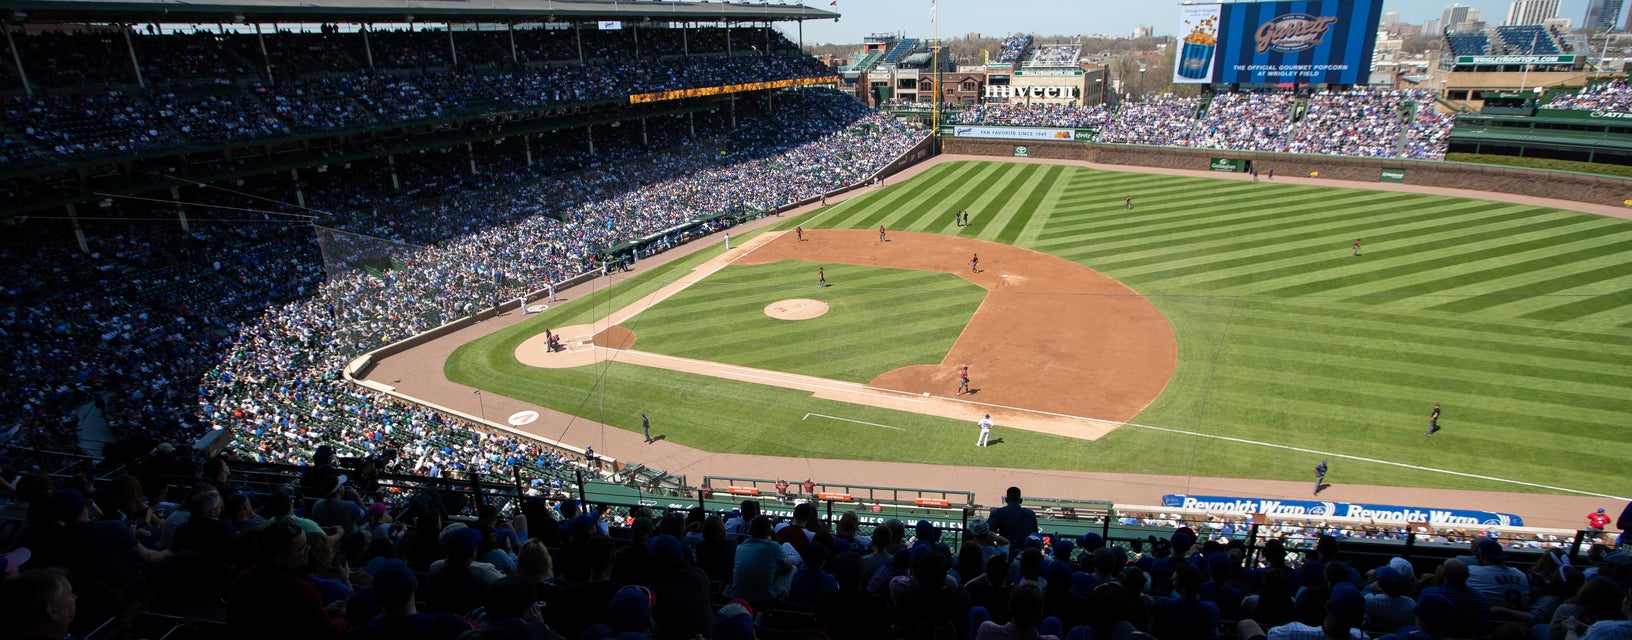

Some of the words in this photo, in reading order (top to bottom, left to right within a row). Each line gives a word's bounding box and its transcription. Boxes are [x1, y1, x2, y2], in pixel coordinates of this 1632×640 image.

[1255, 16, 1338, 54] Garrett
[1473, 56, 1559, 64] WRIGLEYROOFTOPS.COM
[983, 85, 1076, 99] nuveen
[1075, 132, 1091, 140] xfinity
[1183, 497, 1258, 515] Reynolds
[1259, 501, 1306, 515] Wrap
[1347, 504, 1428, 523] Reynolds
[1429, 510, 1479, 525] Wrap
[907, 519, 965, 531] WGLEY
